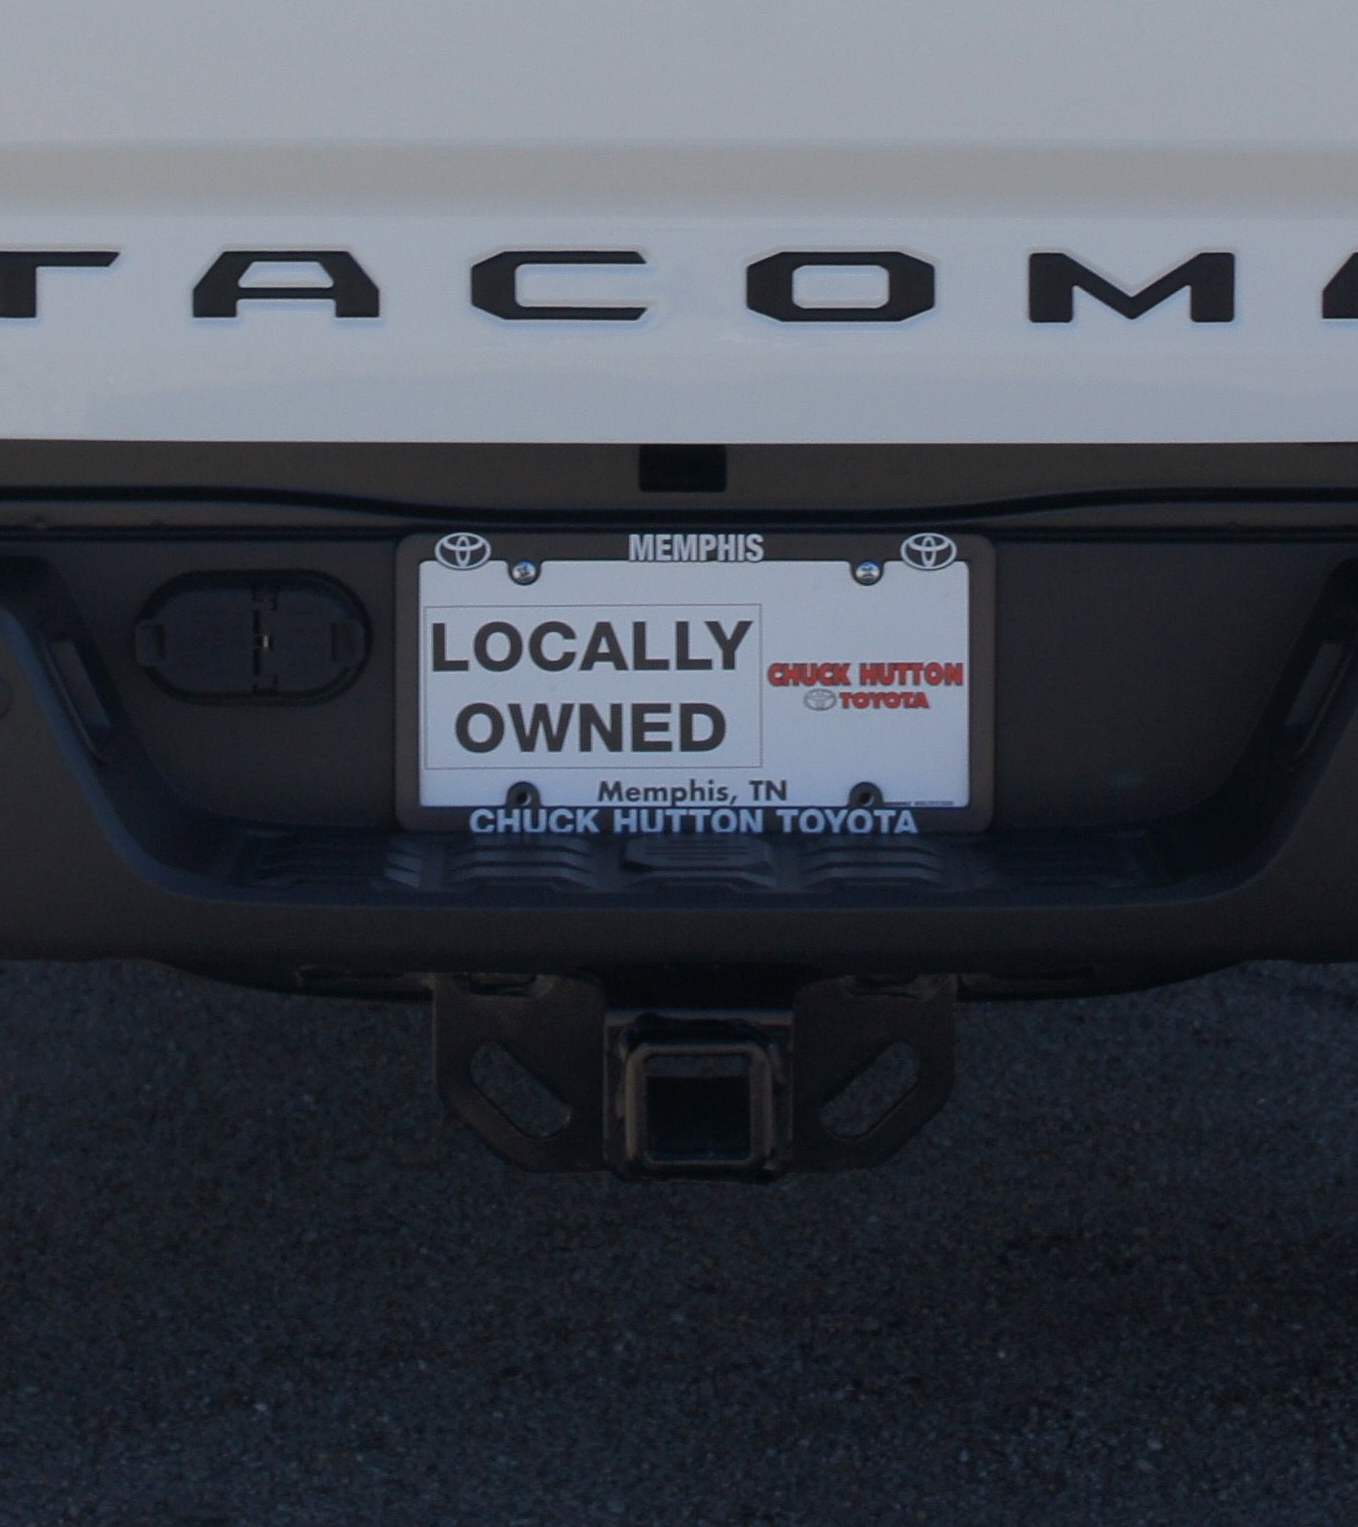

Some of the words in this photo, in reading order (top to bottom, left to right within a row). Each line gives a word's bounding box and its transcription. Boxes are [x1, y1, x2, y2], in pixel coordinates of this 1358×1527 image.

[628, 534, 764, 562] MEMPHIS
[431, 620, 753, 672] LOCALLY
[768, 662, 851, 687] CHUCK
[859, 662, 964, 686] HUTTON
[839, 692, 929, 710] TOYOTA
[455, 702, 727, 753] OWNED
[597, 780, 739, 805] Memphis,
[749, 780, 787, 802] TN
[469, 809, 600, 835] CHUCK
[613, 809, 764, 835] HUTTON
[775, 809, 919, 835] TOYOTA
